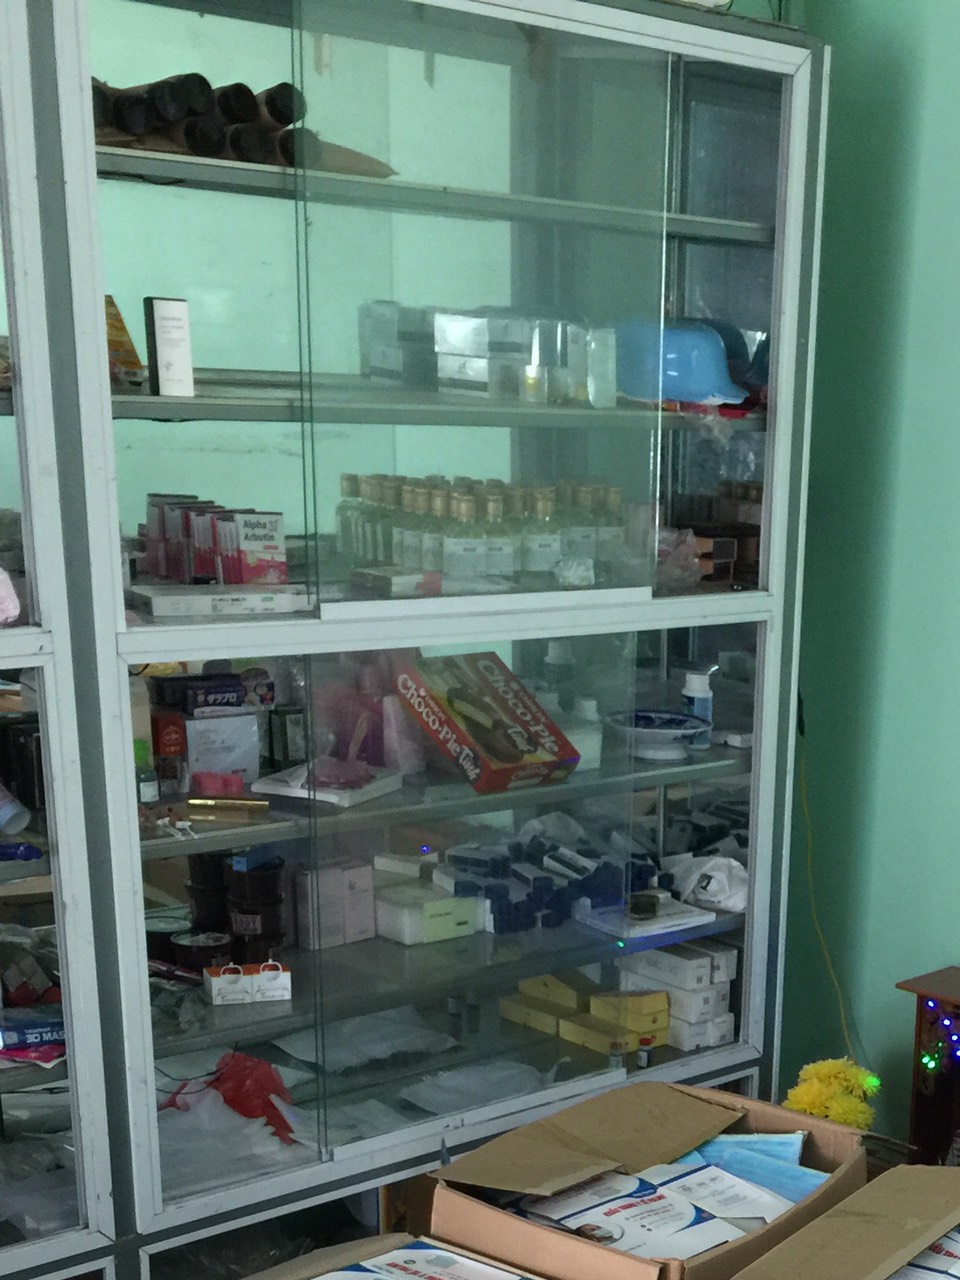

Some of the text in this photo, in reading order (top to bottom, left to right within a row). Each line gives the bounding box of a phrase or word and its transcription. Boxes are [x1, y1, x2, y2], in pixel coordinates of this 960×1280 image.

[243, 519, 267, 531] Alpha
[244, 533, 275, 542] Arbutin
[42, 1030, 66, 1041] MAS
